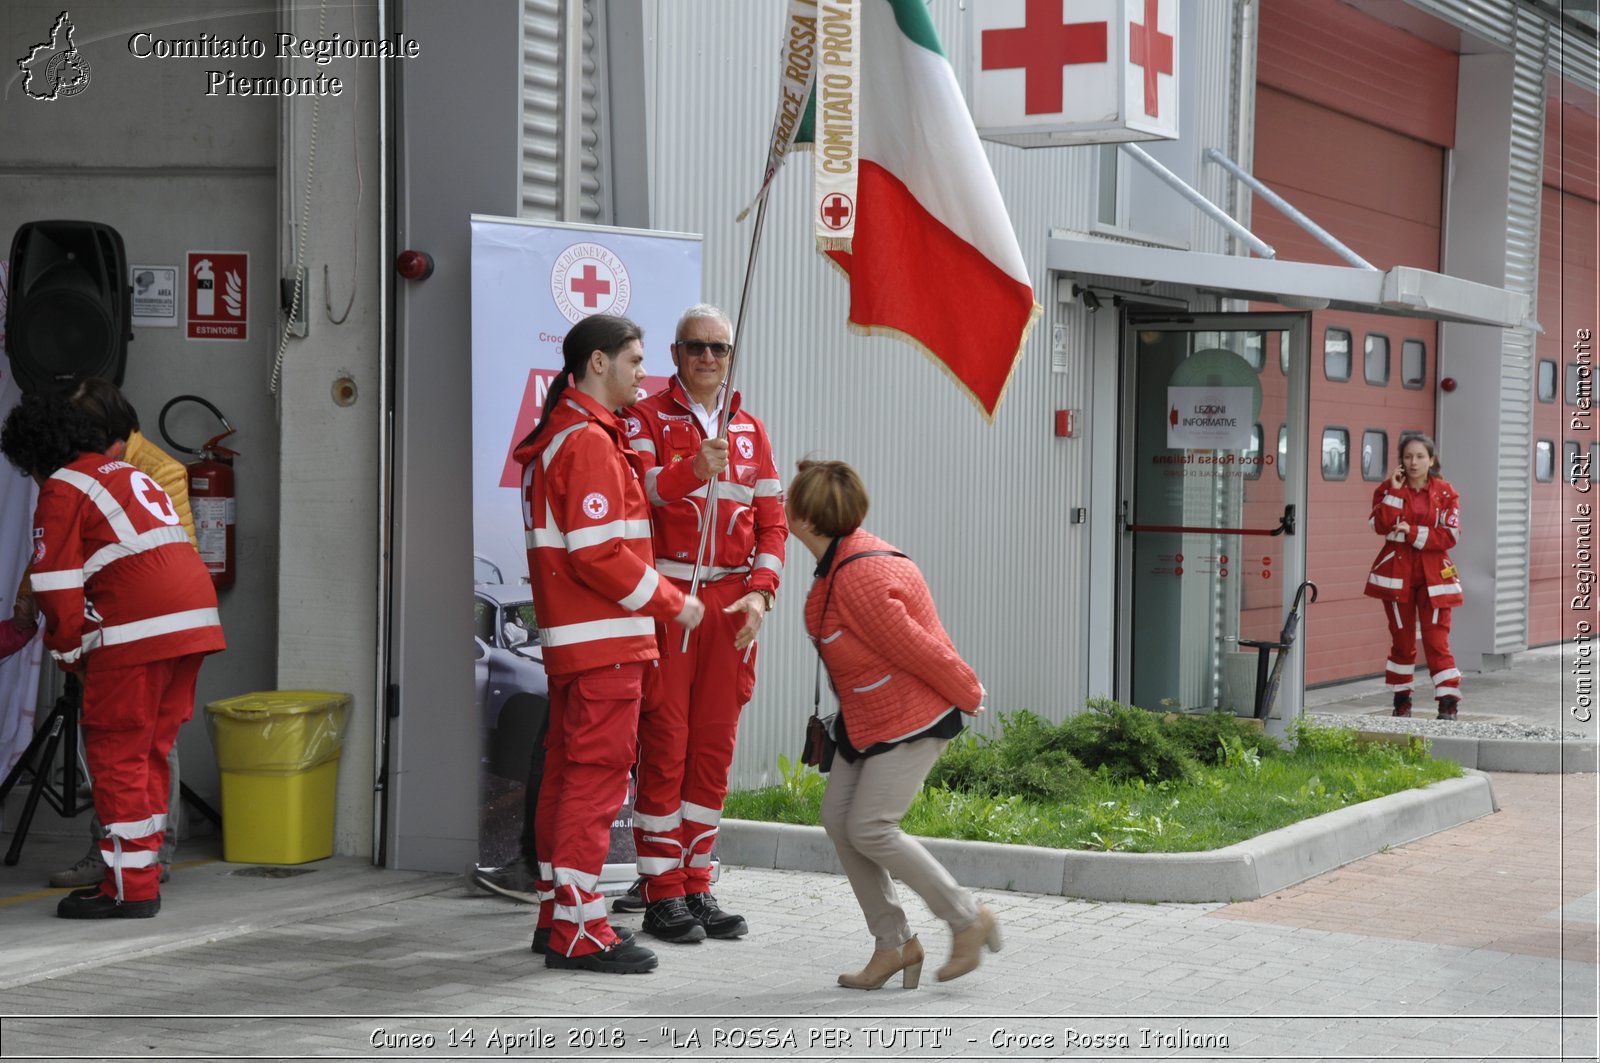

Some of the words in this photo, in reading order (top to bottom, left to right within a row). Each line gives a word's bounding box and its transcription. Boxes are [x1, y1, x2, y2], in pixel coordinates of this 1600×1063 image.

[786, 15, 817, 86] ROSSA
[823, 5, 852, 67] PROV.
[774, 86, 804, 157] CROCE
[823, 74, 853, 174] COMITATO
[574, 245, 613, 266] GINEVRA
[196, 326, 238, 335] ESTINTORE
[1182, 417, 1237, 427] INFORMATIVE
[1194, 404, 1226, 415] LEZIONI
